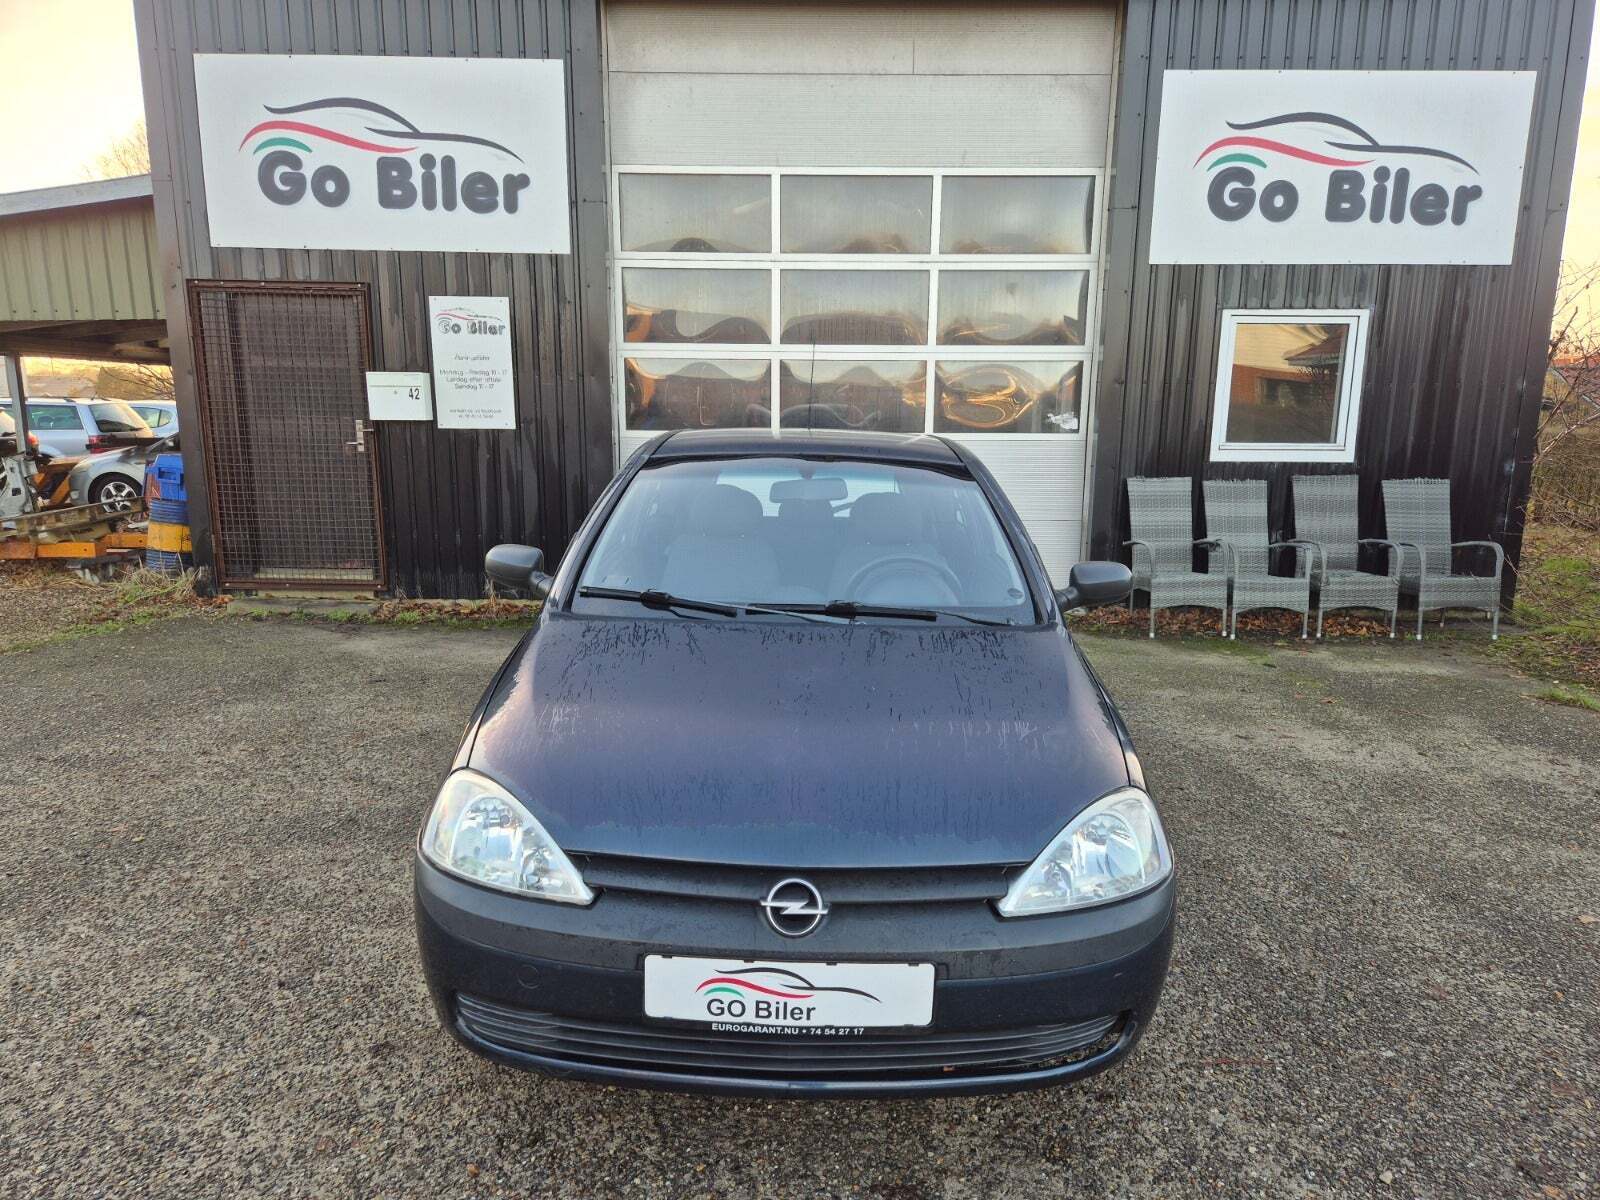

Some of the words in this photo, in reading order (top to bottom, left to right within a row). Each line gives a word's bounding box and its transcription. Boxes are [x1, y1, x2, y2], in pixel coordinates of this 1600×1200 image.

[257, 149, 351, 208] Go
[376, 153, 531, 214] Biler
[1207, 166, 1299, 223] Go
[1325, 165, 1483, 226] Biler
[438, 320, 462, 335] Go
[467, 320, 506, 336] Biler
[408, 388, 420, 400] 42
[706, 998, 746, 1018] GO
[754, 1000, 816, 1021] Biler
[711, 1023, 799, 1035] EUROGARANT.NU
[810, 1027, 821, 1035] 74
[824, 1027, 836, 1035] 54
[838, 1028, 850, 1036] 27
[853, 1028, 865, 1036] 17
